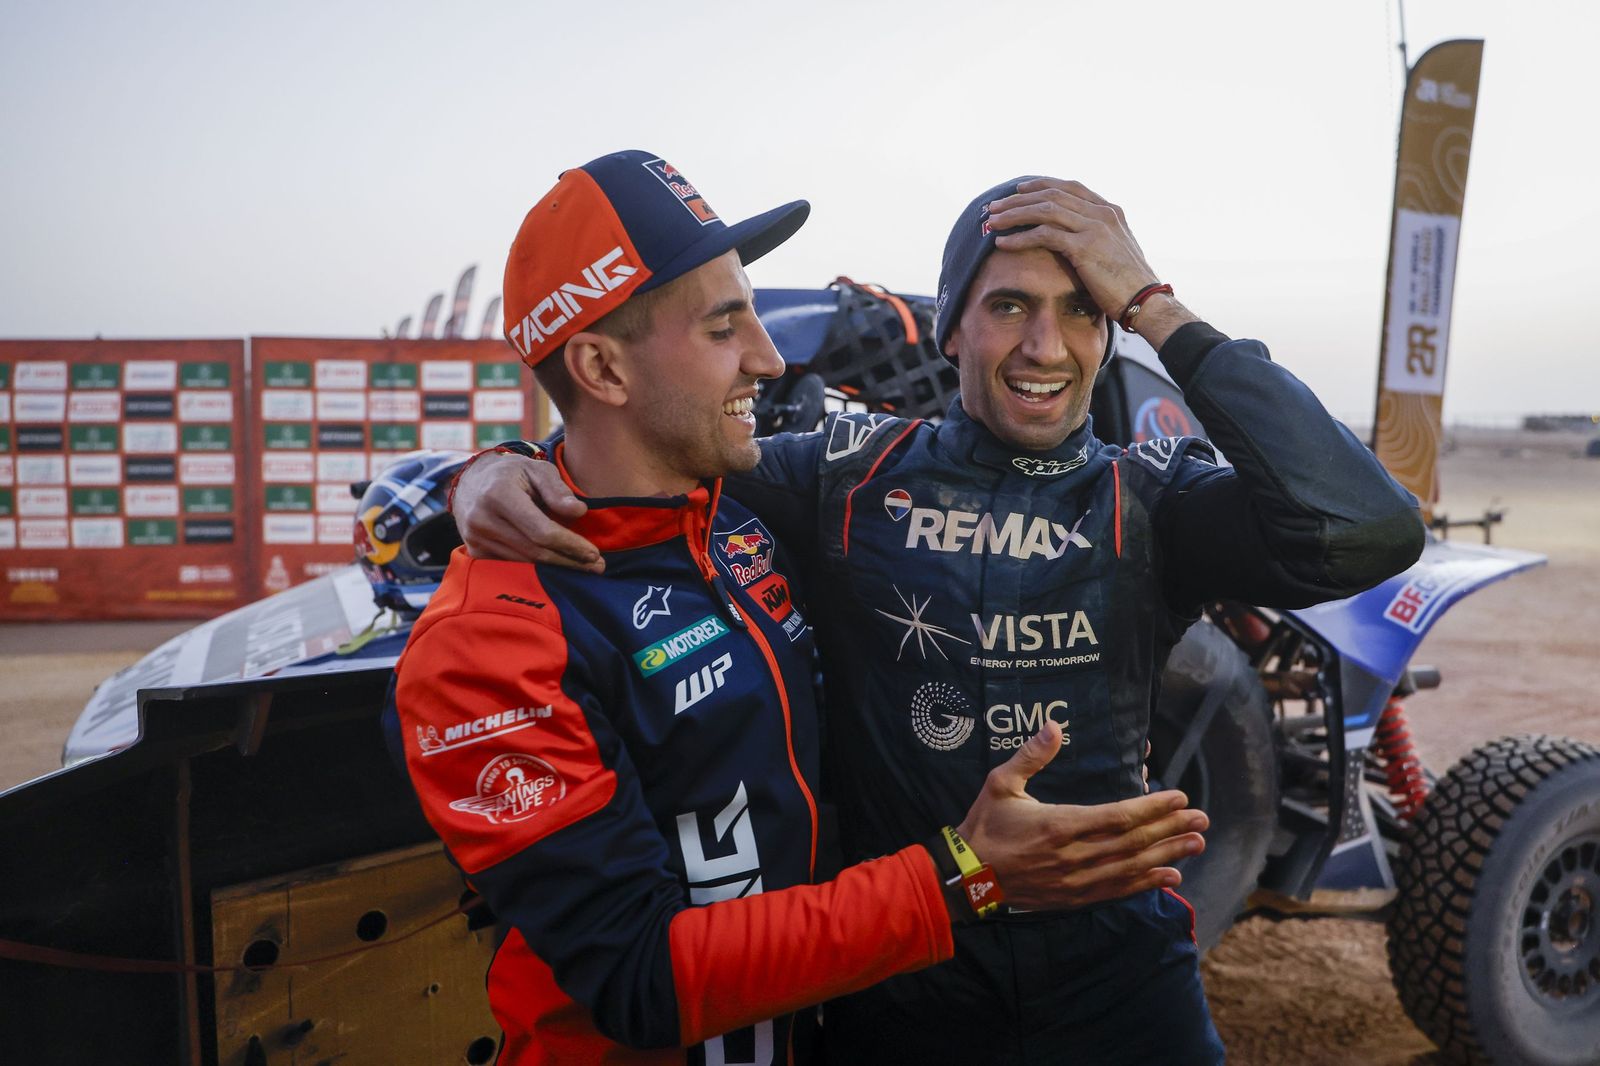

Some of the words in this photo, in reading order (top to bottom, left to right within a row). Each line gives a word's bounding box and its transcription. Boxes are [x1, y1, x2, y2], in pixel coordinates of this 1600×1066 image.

[762, 583, 787, 614] KTM
[661, 617, 725, 660] MOTOREX
[970, 610, 1099, 652] VISTA
[970, 656, 1013, 669] ENERGY
[1015, 659, 1038, 668] FOR
[1039, 652, 1101, 667] TOMORROW
[444, 704, 553, 742] MICHELIN
[986, 700, 1070, 734] GMC
[512, 791, 544, 816] LIFE
